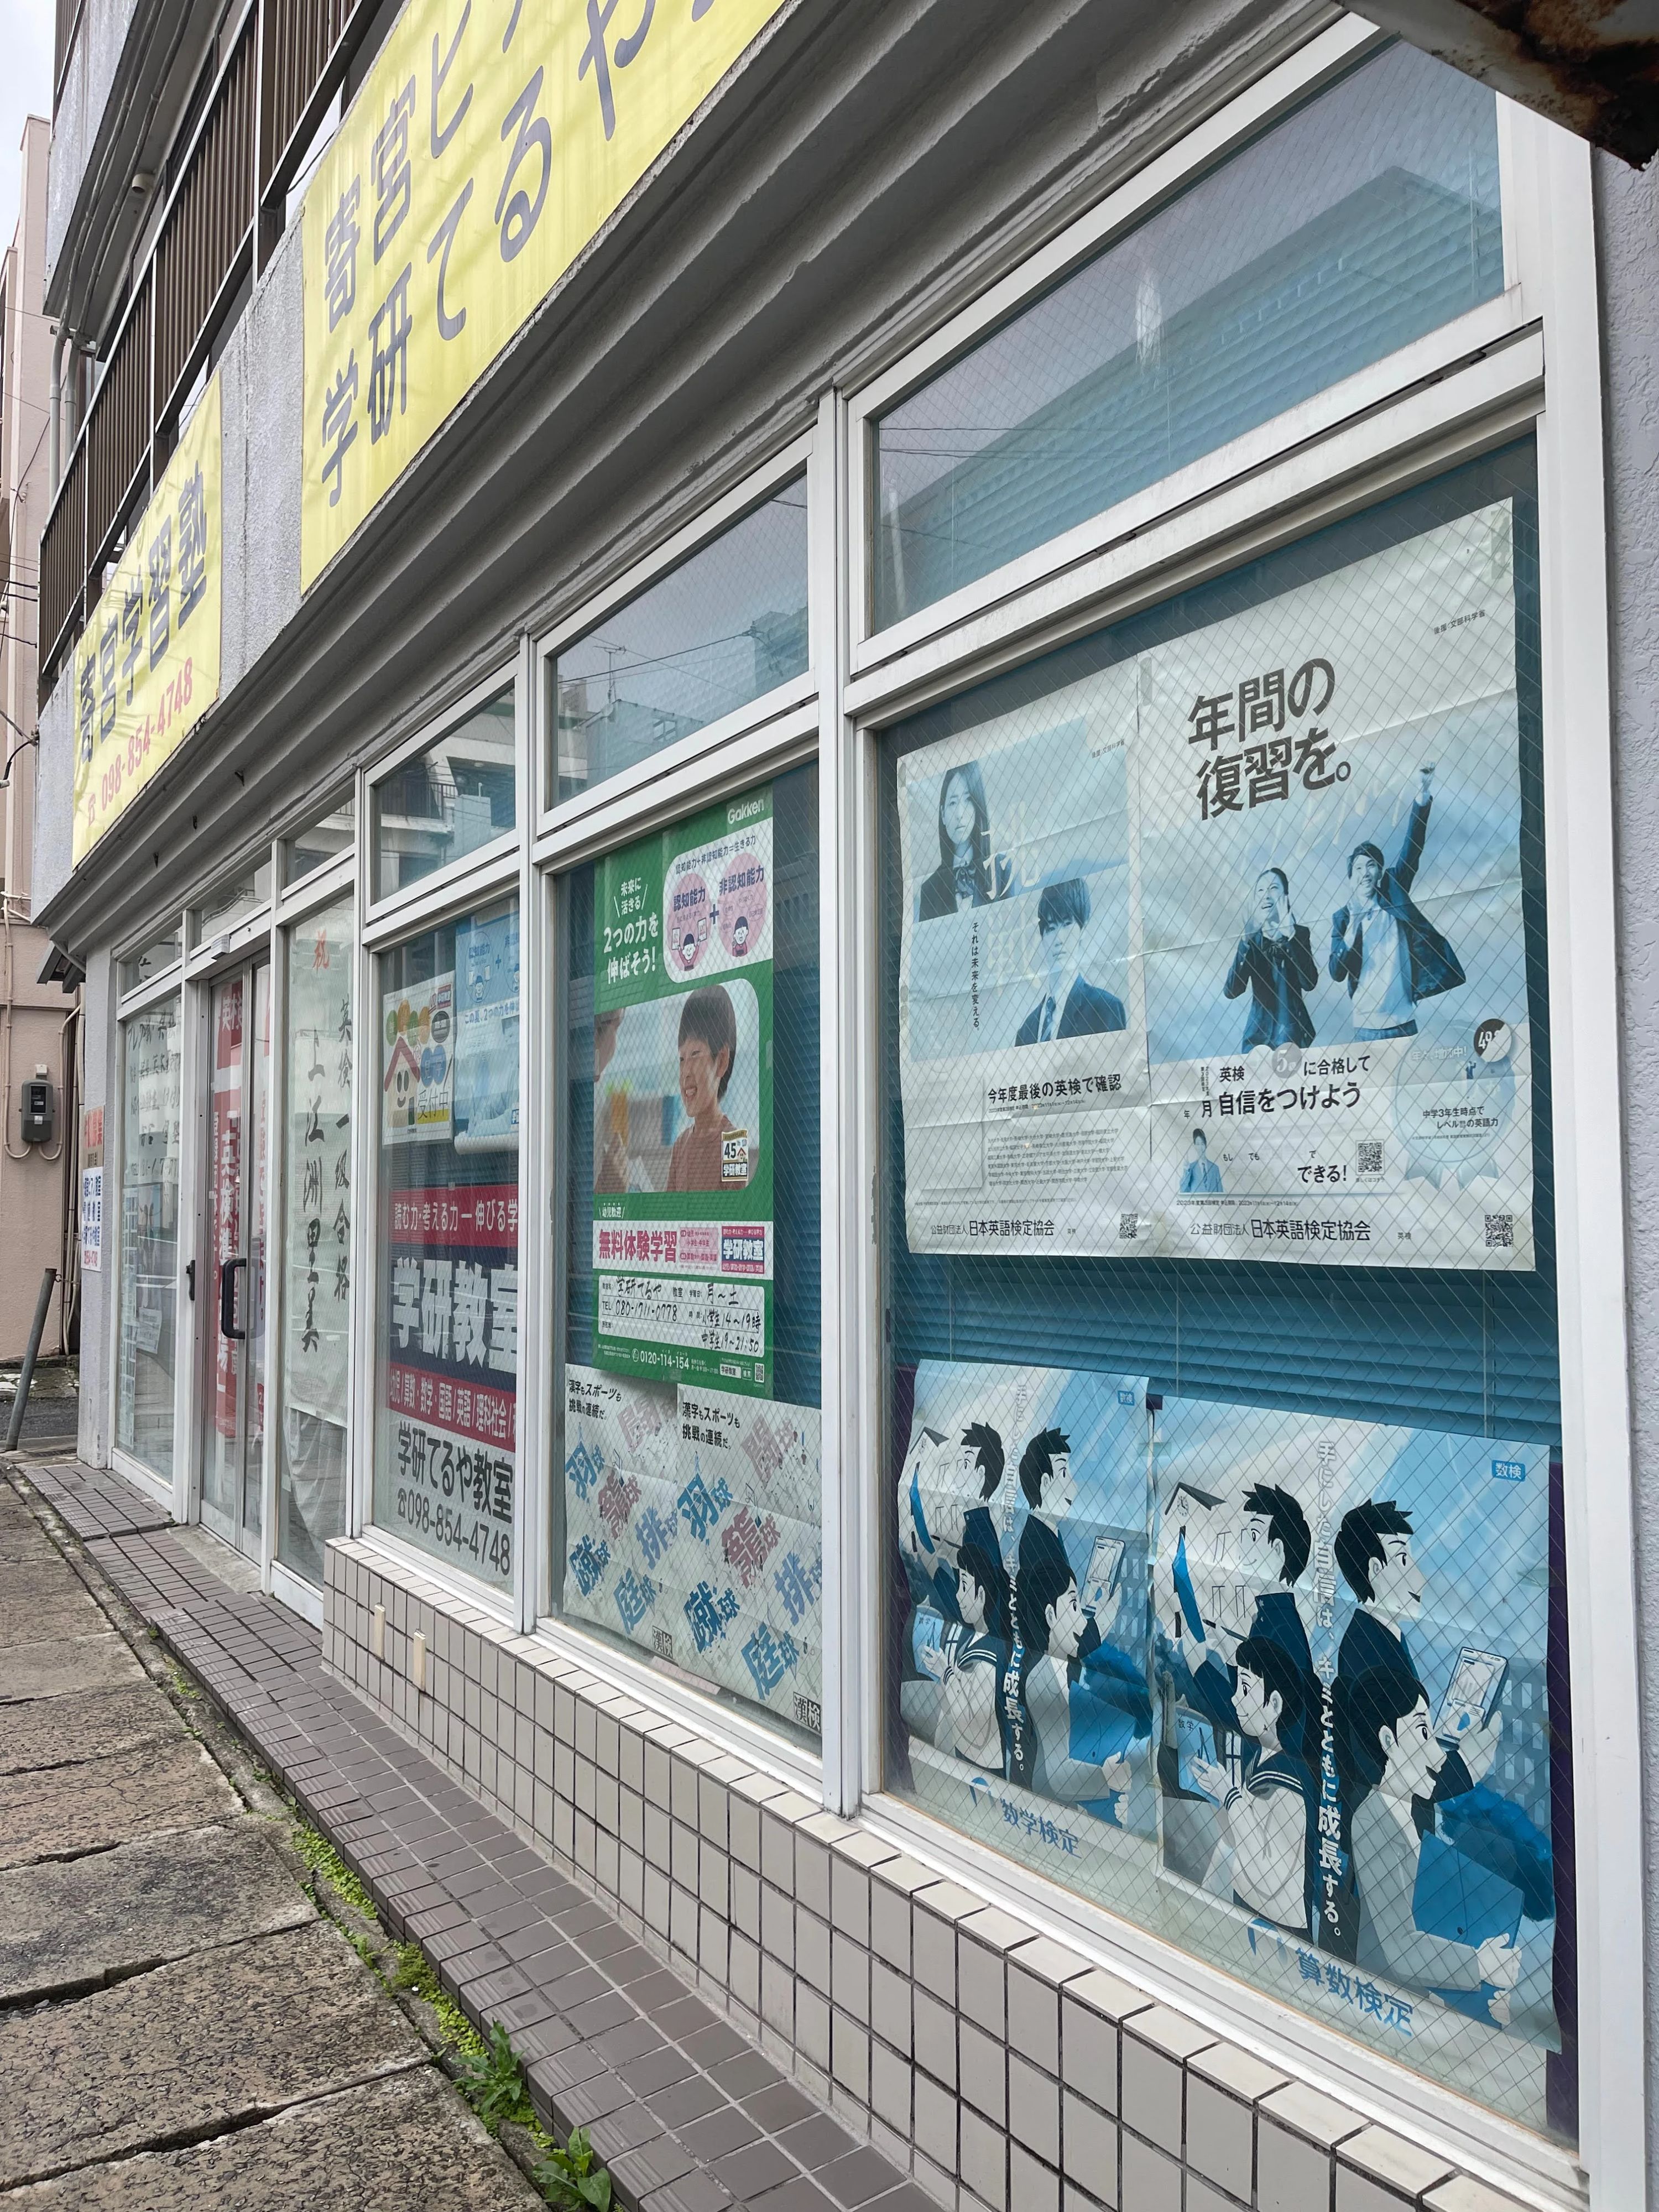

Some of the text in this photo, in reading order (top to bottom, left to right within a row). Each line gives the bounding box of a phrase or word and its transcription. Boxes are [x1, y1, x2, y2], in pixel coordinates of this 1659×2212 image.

[80, 460, 207, 764] 寄宮学習塾
[1188, 658, 1335, 751] 年間の
[101, 658, 193, 811] 098-854-4748
[1197, 727, 1352, 820] 復習を。
[727, 798, 764, 825] Gakken
[620, 877, 642, 896] 未来に
[719, 865, 764, 895] 非認知能力
[620, 895, 641, 915] 活きる
[673, 886, 706, 912] 認知能力
[603, 910, 659, 953] 2つの力を
[312, 929, 330, 971] 祝
[607, 945, 656, 984] 伸ばそう!
[971, 922, 981, 1031] それは未来を変える。
[1219, 1066, 1245, 1083] 英検
[1303, 1054, 1370, 1077] に合格して
[417, 1087, 449, 1120] 受付中
[988, 1073, 1122, 1105] 今年度最後の英検で確認
[1219, 1081, 1361, 1117] 自信をつけよう
[1423, 1106, 1485, 1118] 中学3年生時点で
[724, 1143, 736, 1159] 45
[1297, 1165, 1347, 1183] できる!
[969, 1219, 1055, 1237] 日本英語検定協会
[1191, 1223, 1248, 1237] 公益財団法人
[1250, 1219, 1371, 1241] 日本英語検定協会
[599, 1229, 677, 1264] 無料体験学習
[723, 1239, 764, 1261] 学研教室
[602, 1301, 612, 1311] TEL
[672, 1287, 684, 1298] 教室
[393, 1256, 519, 1374] 学研教室
[640, 1350, 690, 1370] 0120-114-154
[569, 1379, 622, 1401] 漢字もスポーツも
[569, 1398, 608, 1420] 挑戦の連続だ。
[682, 1402, 740, 1428] 漢字もスポーツも
[682, 1423, 732, 1450] 挑戦の連続だ。
[398, 1420, 514, 1524] 学研てるや教室
[1495, 1462, 1522, 1480] 数検
[677, 1472, 733, 1539] 羽球
[408, 1492, 511, 1576] 098-854-4748
[652, 1625, 673, 1660] 漢検
[740, 1620, 799, 1700] 庭球
[794, 1692, 821, 1733] 漢検
[1001, 1798, 1082, 1859] 数学検定
[1295, 1946, 1415, 2037] 算数検定
